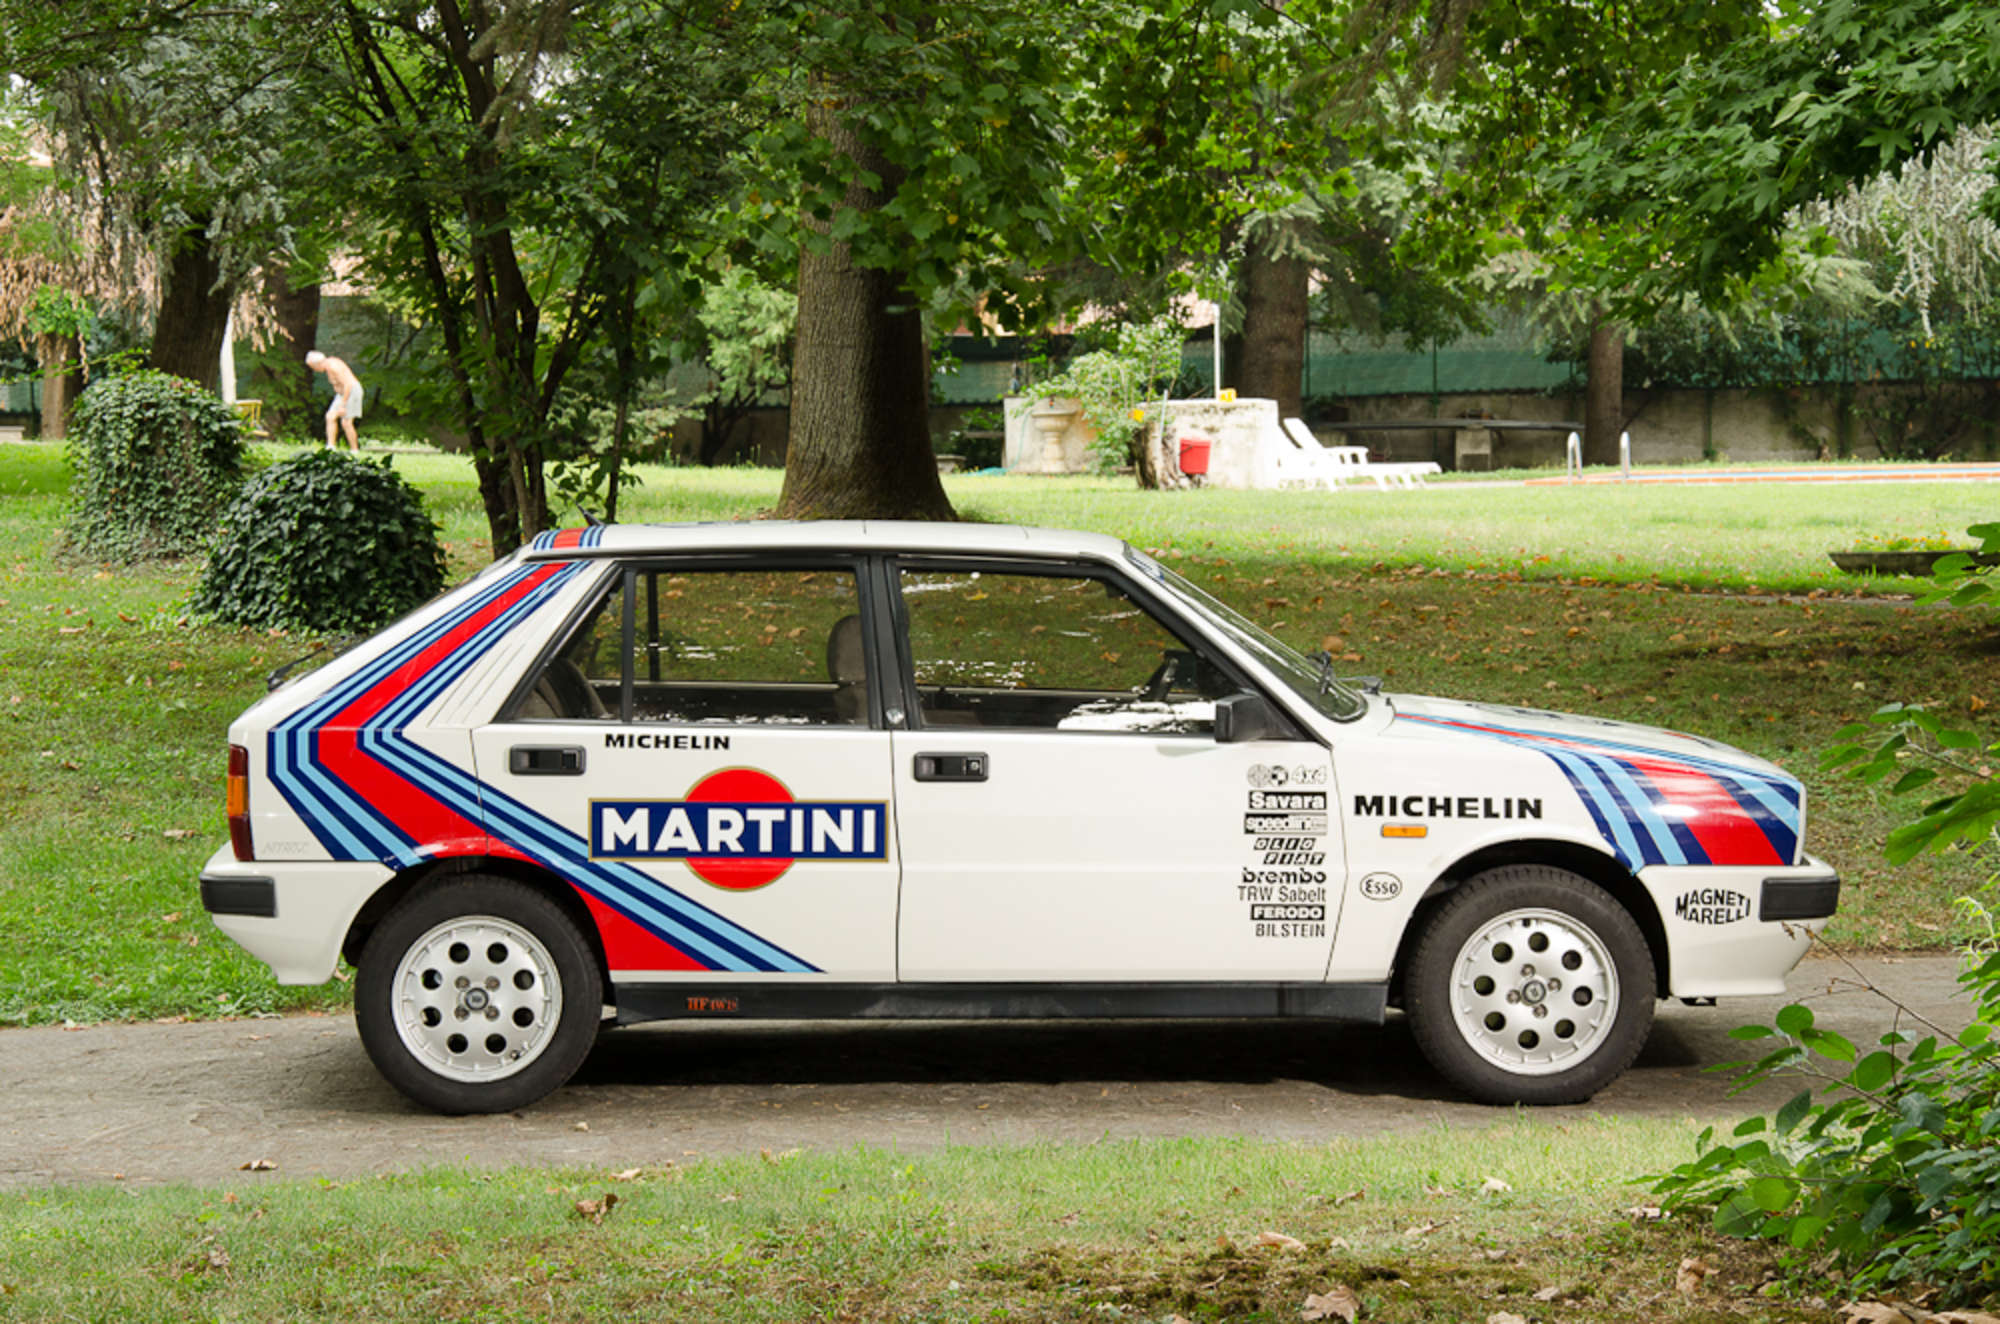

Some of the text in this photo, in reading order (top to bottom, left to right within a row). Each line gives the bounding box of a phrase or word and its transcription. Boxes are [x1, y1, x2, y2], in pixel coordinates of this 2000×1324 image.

[604, 733, 730, 750] MICHELIN
[1250, 791, 1325, 809] Savara
[1354, 795, 1543, 819] MICHELIN
[601, 807, 876, 853] MARTINI
[1253, 837, 1317, 850] OLIO
[1262, 851, 1326, 865] FIAT
[1242, 866, 1327, 884] brembo
[1237, 885, 1326, 902] TRW Sabelt
[1675, 888, 1751, 914] MAGNETI
[1253, 905, 1324, 920] FERODO
[1675, 903, 1751, 925] MARELLI
[1255, 923, 1325, 937] BILSTEIN
